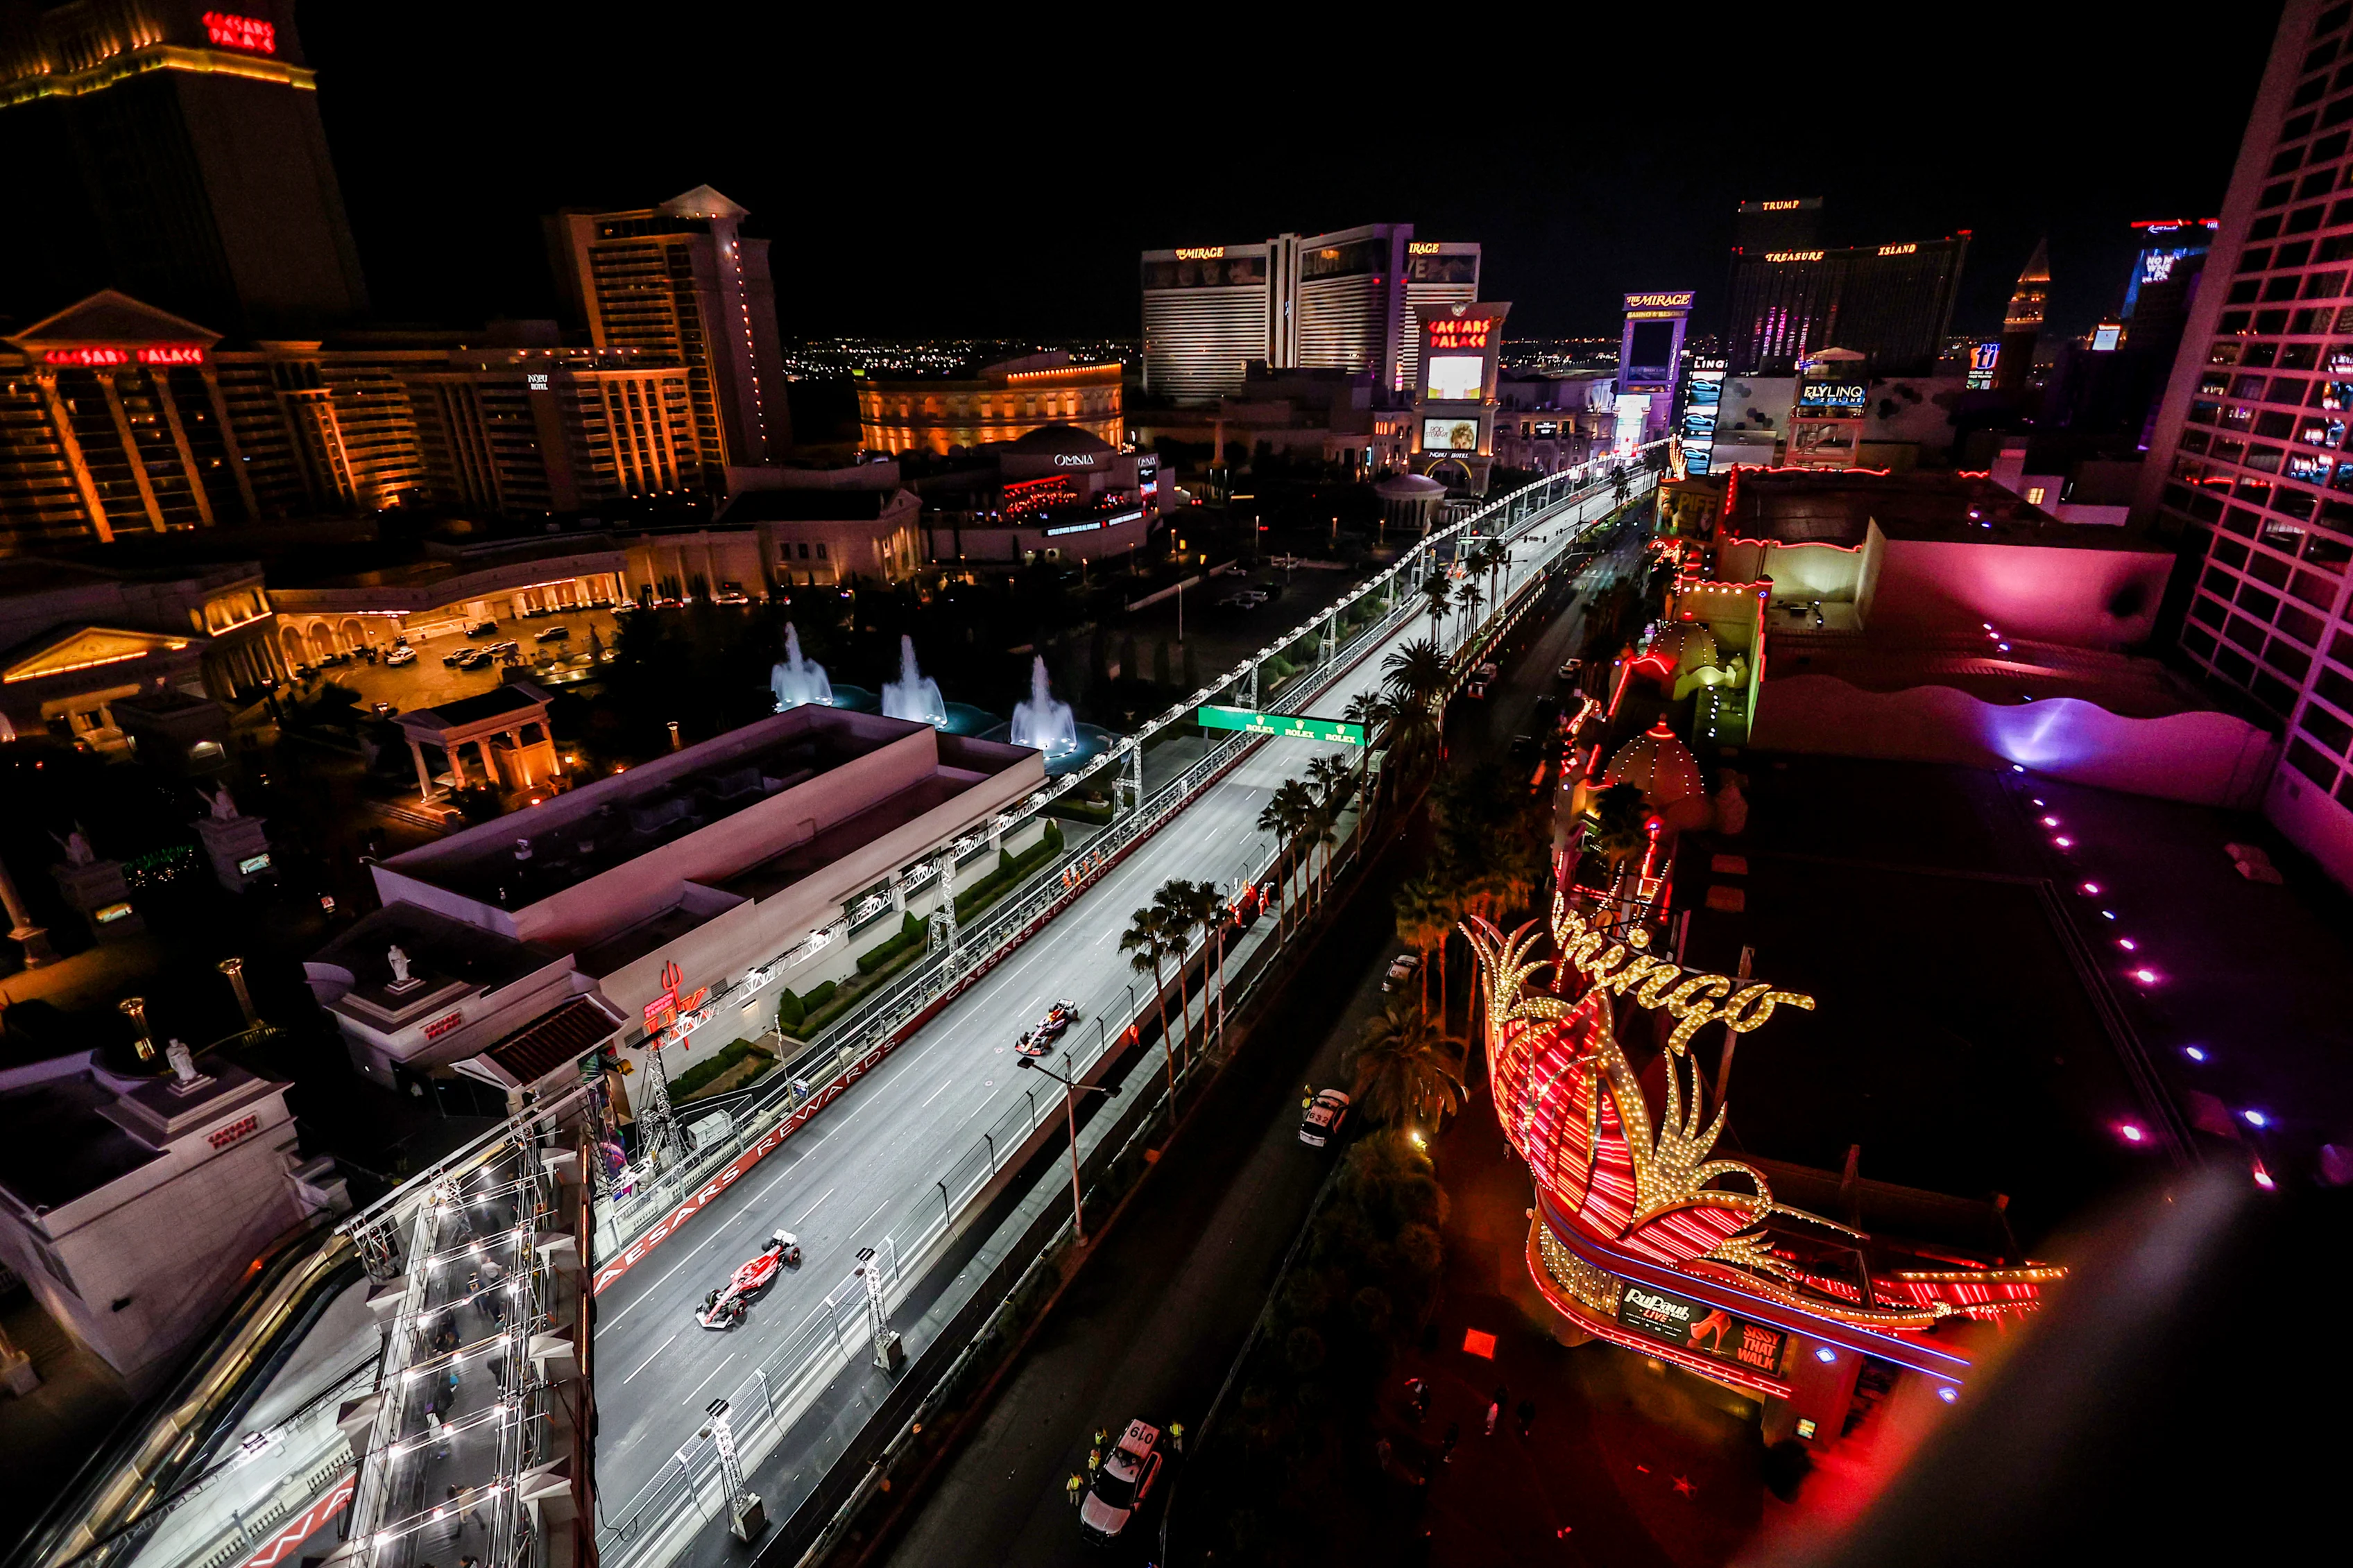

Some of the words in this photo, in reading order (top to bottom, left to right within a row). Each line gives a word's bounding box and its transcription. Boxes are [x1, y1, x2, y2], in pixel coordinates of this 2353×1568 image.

[1763, 200, 1799, 210] TRUMP
[1179, 247, 1224, 260] MIRAGE
[1409, 243, 1439, 255] IRAGE
[1765, 252, 1824, 262] TREASURE
[1878, 244, 1916, 256] ISLAND
[1631, 294, 1691, 307] MIRAGE
[1428, 320, 1491, 334] CAESARS
[1430, 334, 1487, 348] PALACE
[44, 348, 129, 366] CAESARS
[137, 347, 204, 365] PALACE
[1694, 360, 1725, 368] LINQ
[1804, 386, 1863, 397] FLYLINQ
[1054, 454, 1094, 466] OMNIA
[1679, 492, 1716, 514] PIFF
[1246, 723, 1275, 734] ROLEX
[1285, 728, 1315, 739] ROLEX
[1325, 733, 1356, 743] ROLEX
[1143, 795, 1195, 839] CAESARS
[946, 926, 1034, 1001] CAESARS
[1042, 861, 1115, 924] REWARDS
[594, 1165, 741, 1294] AESARS
[757, 1038, 896, 1157] REWARDS
[1643, 1309, 1669, 1323] LIVE
[1652, 1307, 1670, 1316] DRAG
[1744, 1324, 1782, 1345] SISSY
[1743, 1336, 1777, 1357] THAT
[1738, 1347, 1775, 1371] WALK
[1130, 1426, 1154, 1445] 019
